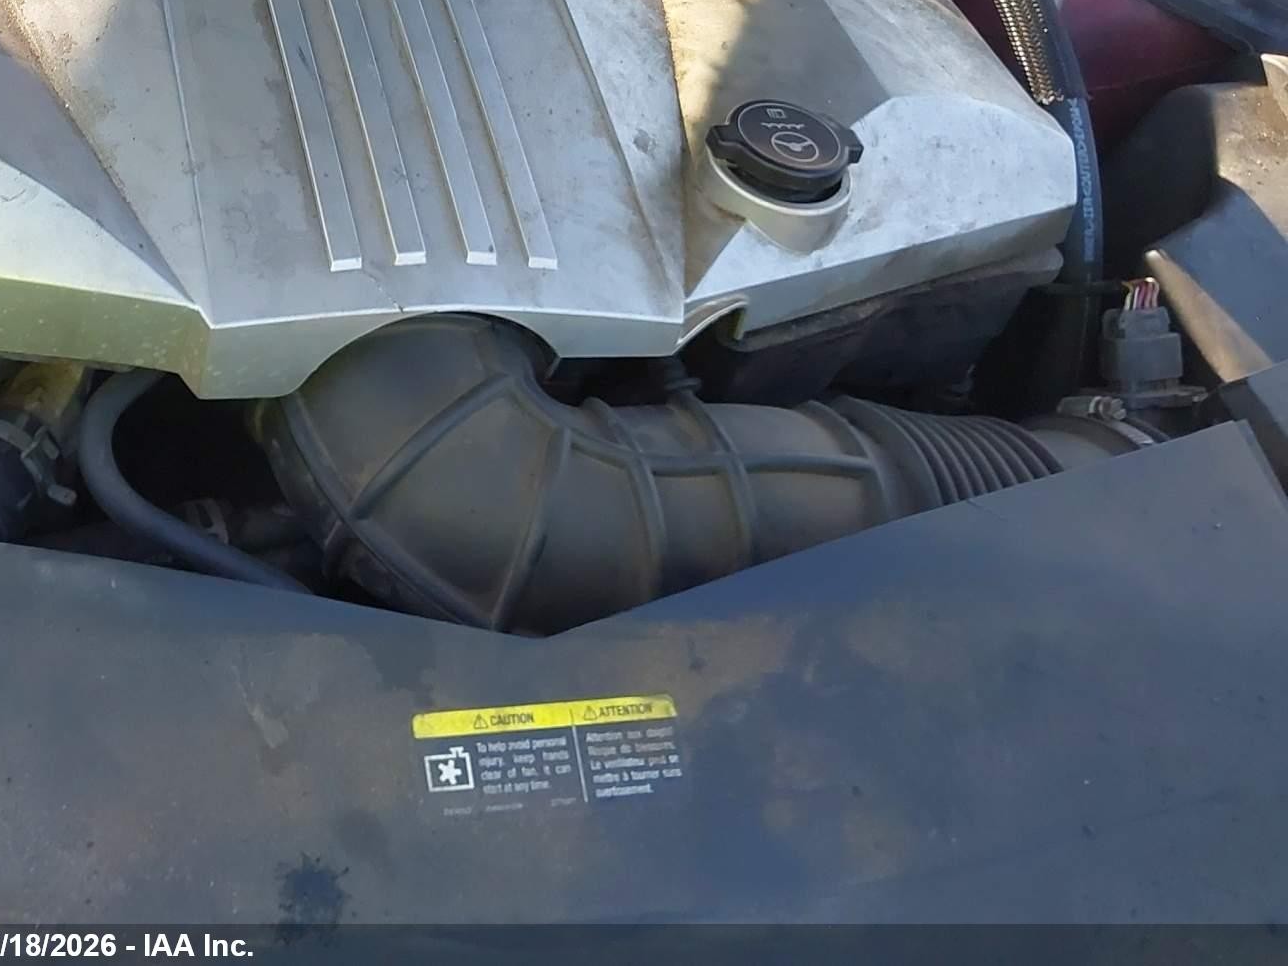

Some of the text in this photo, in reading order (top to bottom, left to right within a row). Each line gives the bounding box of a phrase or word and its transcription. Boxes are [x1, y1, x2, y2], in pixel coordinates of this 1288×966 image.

[599, 703, 653, 717] ATTENTION
[490, 714, 535, 726] CAUTION
[476, 736, 567, 753] To help avoid personal
[555, 764, 571, 775] can
